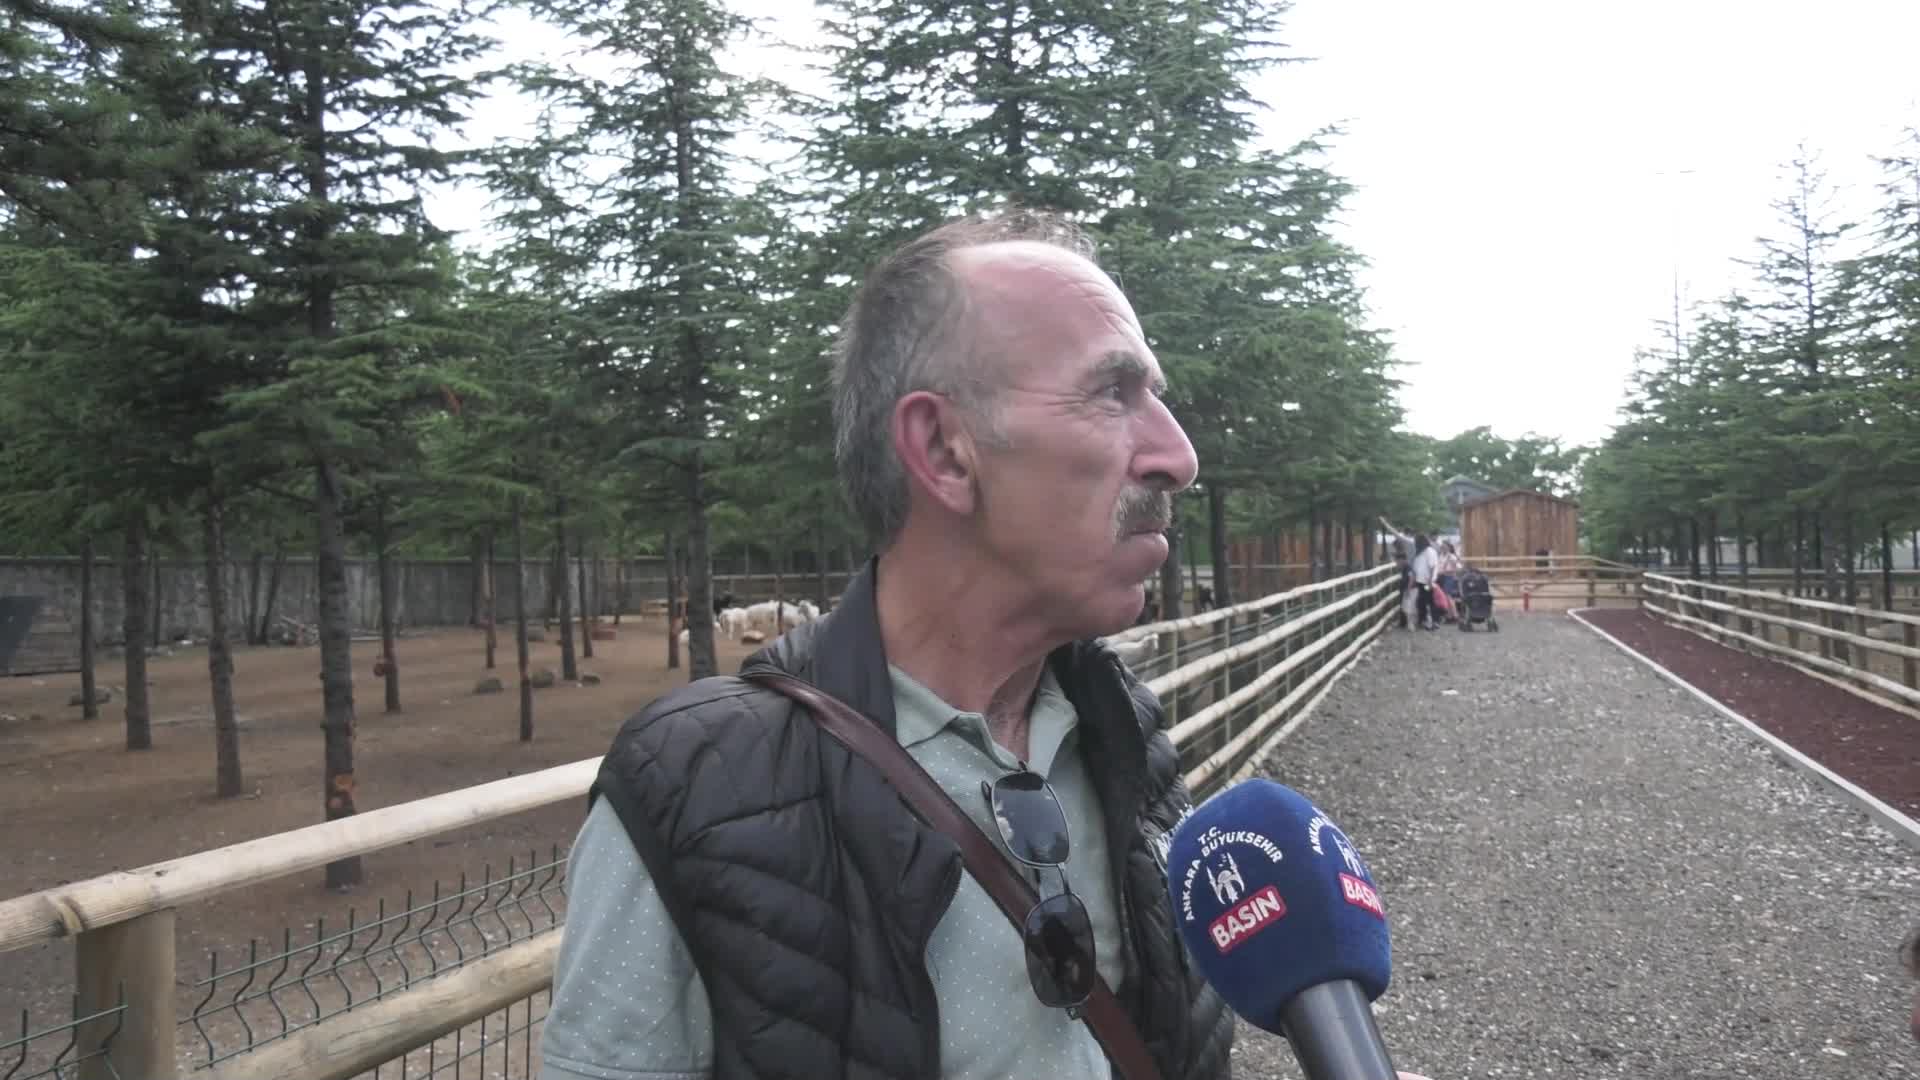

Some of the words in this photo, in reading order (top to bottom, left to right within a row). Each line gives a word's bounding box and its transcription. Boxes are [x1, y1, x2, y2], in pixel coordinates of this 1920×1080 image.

[1197, 826, 1221, 845] T.C.
[1182, 858, 1201, 921] ANKARA
[1211, 890, 1281, 949] BASIN
